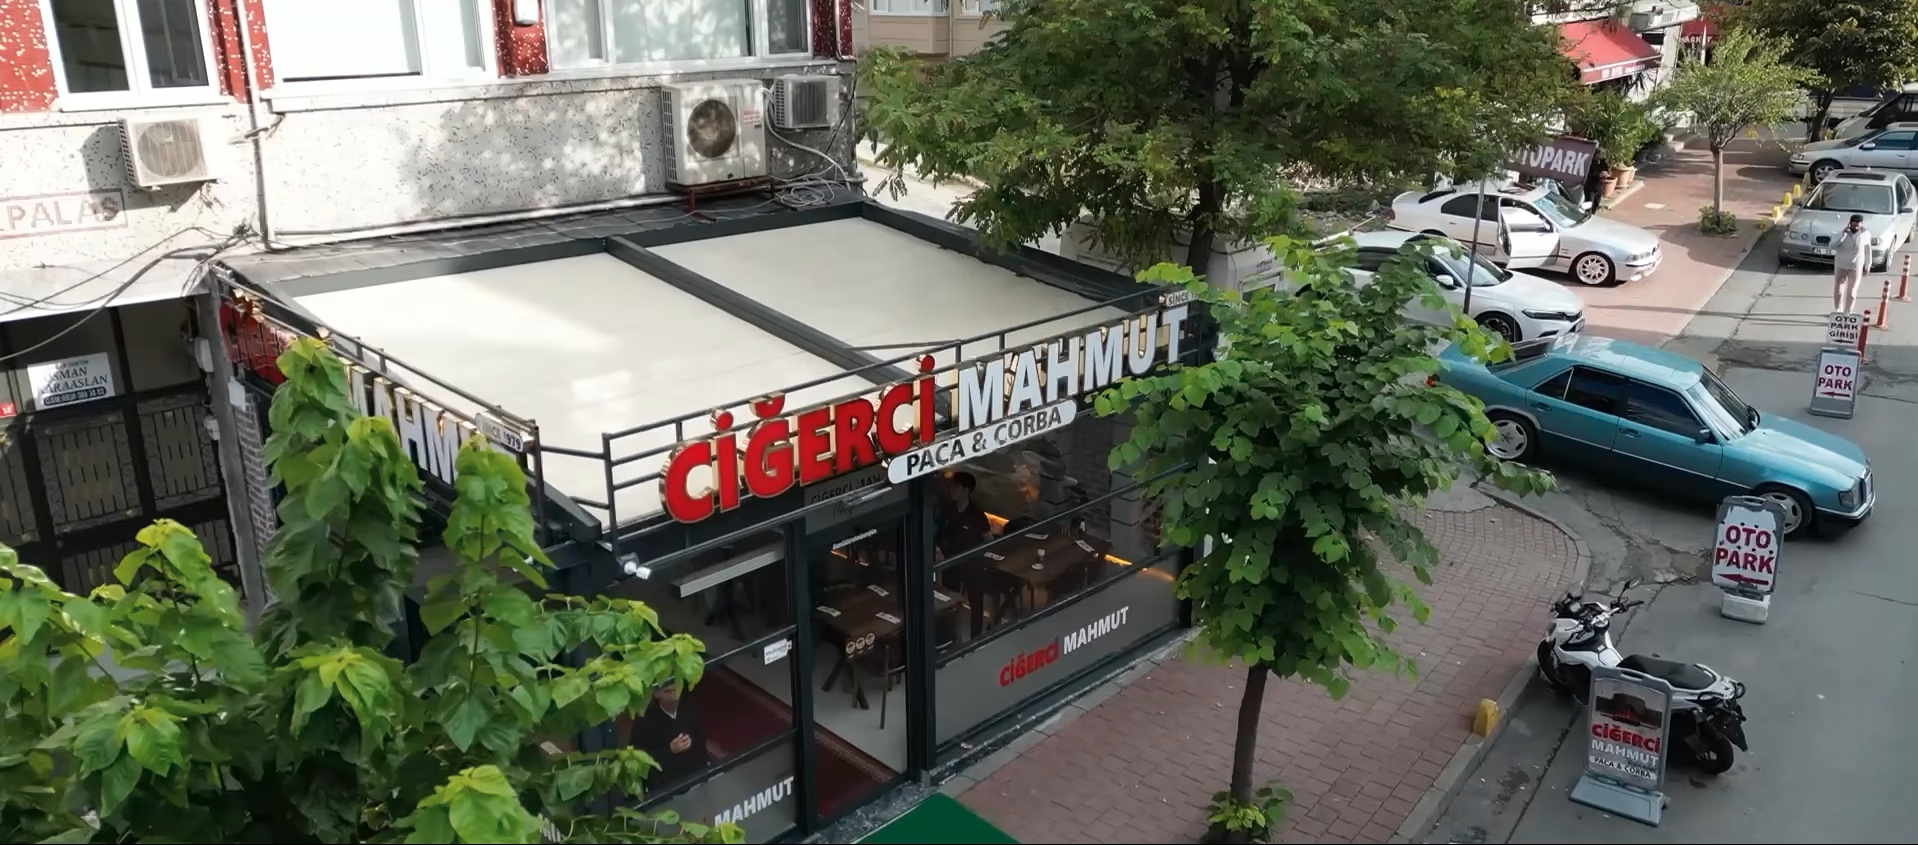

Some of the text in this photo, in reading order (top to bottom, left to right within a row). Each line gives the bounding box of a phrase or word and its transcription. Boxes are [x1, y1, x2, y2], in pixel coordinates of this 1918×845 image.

[1508, 144, 1590, 177] TOPARK
[1835, 315, 1857, 324] OTO
[1817, 377, 1853, 391] PARK
[1824, 364, 1852, 377] OTO
[660, 304, 1190, 524] CİĞERCİ MAHMUT
[972, 431, 987, 453] &
[1726, 525, 1771, 549] OTO
[1715, 547, 1775, 574] PARK
[1000, 605, 1130, 687] CİĞERCİ MAHMUT
[1591, 722, 1661, 754] CİĞERCİ
[1591, 739, 1660, 766] MAHMUT
[713, 775, 795, 826] MAHMUT
